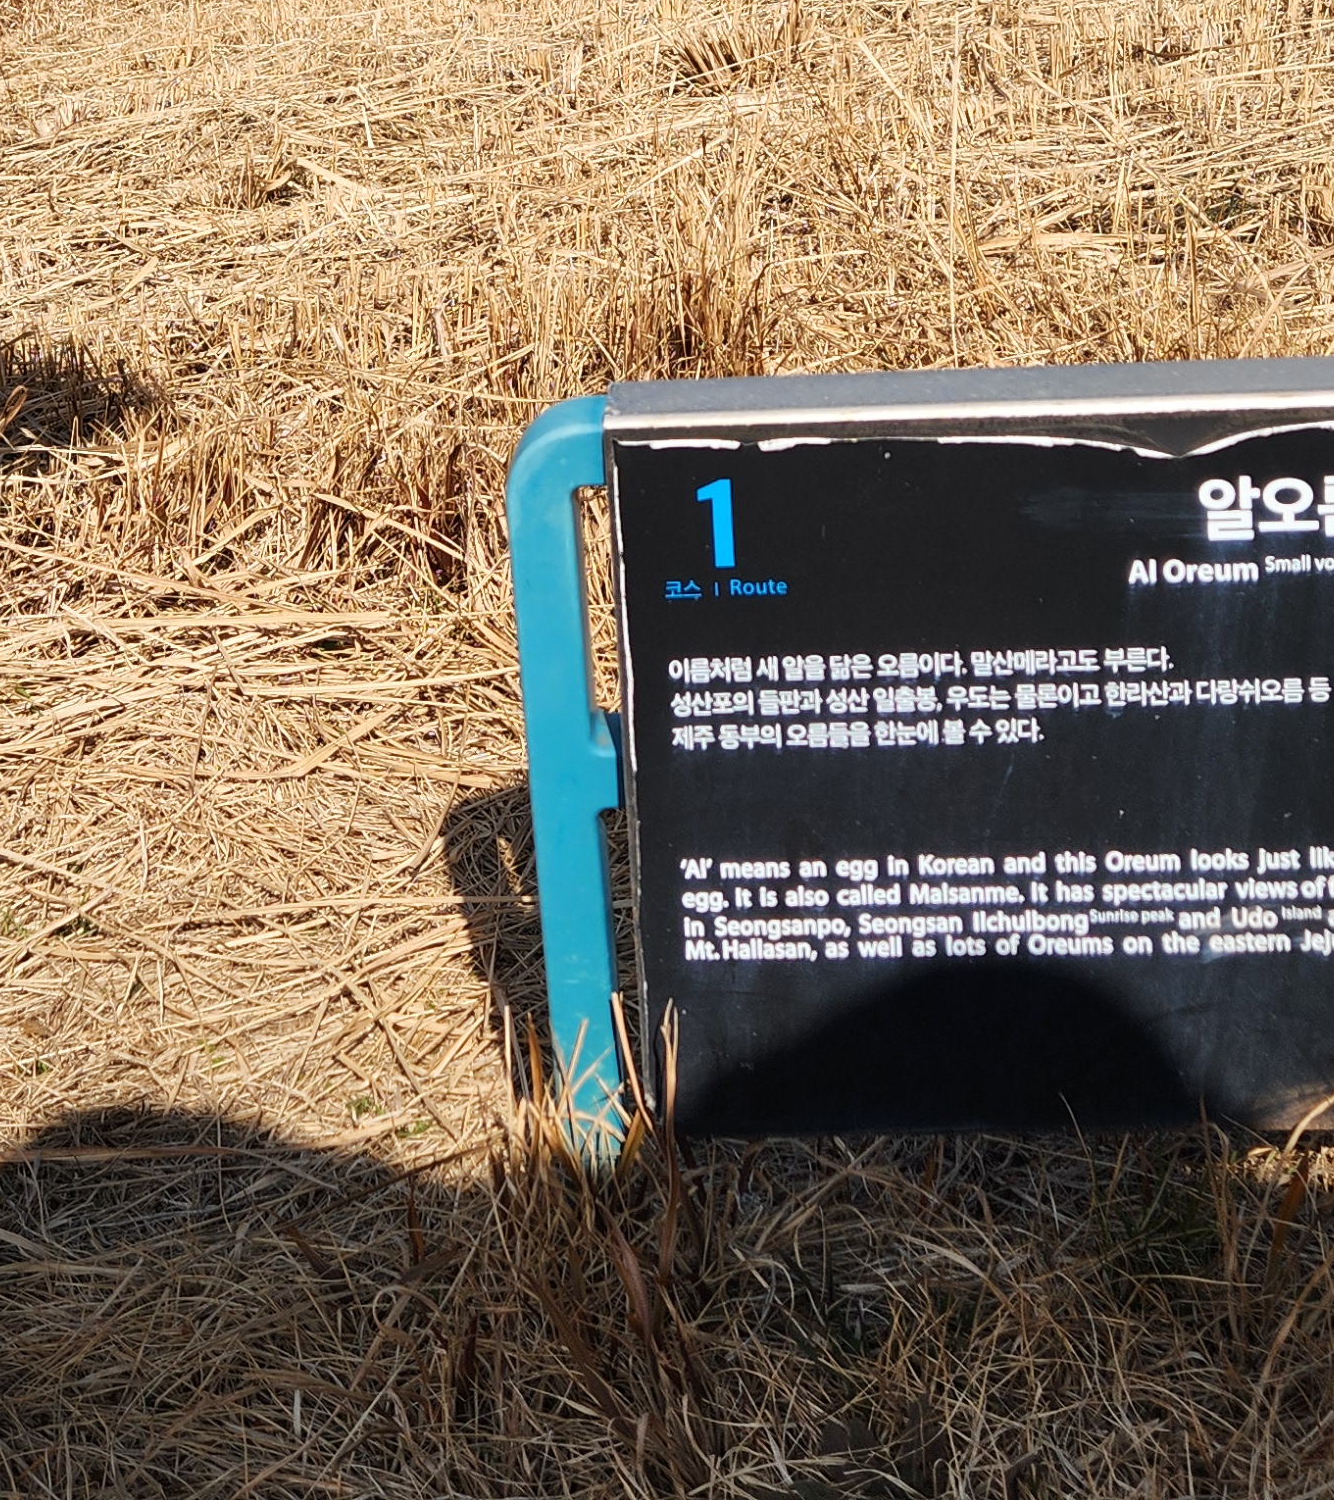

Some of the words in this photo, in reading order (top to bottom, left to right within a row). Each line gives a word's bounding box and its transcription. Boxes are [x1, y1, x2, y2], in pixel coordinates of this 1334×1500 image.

[696, 478, 735, 568] 1
[1128, 559, 1157, 585] Al
[1163, 558, 1259, 584] Oreum
[1265, 555, 1311, 573] Small
[665, 580, 702, 598] 코스
[730, 579, 788, 595] Route
[669, 656, 752, 683] 이름처럼
[756, 656, 779, 681] 새
[782, 655, 826, 682] 알을
[877, 651, 967, 679] 오름이다.
[1103, 646, 1175, 673] 부른다.
[671, 689, 754, 717] 성산포의
[758, 688, 822, 715] 들판과
[826, 687, 868, 714] 성산
[946, 684, 1011, 710] 우도는
[1014, 682, 1102, 710] 물론이고
[1103, 680, 1193, 707] 한라산과
[1196, 678, 1305, 705] 다랑쉬오름
[1308, 676, 1332, 703] 등
[671, 725, 715, 750] 제주
[718, 723, 782, 749] 동부의
[786, 721, 870, 748] 오름들을
[874, 719, 939, 746] 한눈에
[942, 719, 966, 744] 볼
[968, 718, 992, 744] 수
[995, 717, 1045, 743] 있다.
[719, 860, 791, 879] means
[799, 859, 827, 878] an
[836, 858, 879, 881] egg
[887, 855, 909, 876] in
[918, 854, 995, 875] Korean
[1003, 851, 1046, 874] and
[1055, 851, 1097, 873] this
[1105, 851, 1181, 873] Oreum
[1191, 848, 1250, 871] looks
[1257, 847, 1301, 874] just
[681, 891, 729, 912] egg.
[735, 887, 753, 907] It
[759, 886, 778, 907] is
[785, 885, 830, 907] also
[836, 883, 901, 906] called
[909, 882, 1025, 905] Malsanme.
[1031, 881, 1049, 903] It
[1055, 880, 1095, 902] has
[1102, 877, 1228, 906] spectacular
[1235, 877, 1298, 899] views
[1300, 876, 1326, 898] of
[684, 916, 705, 937] in
[714, 915, 851, 940] Seongsanpo,
[858, 913, 963, 937] Seongsan
[972, 909, 1089, 936] Ilchulbong
[1141, 908, 1175, 924] peak
[1178, 907, 1221, 930] and
[1231, 905, 1278, 929] Udo
[722, 938, 817, 962] Hallasan,
[825, 941, 849, 959] as
[857, 936, 902, 958] well
[912, 938, 936, 957] as
[945, 934, 987, 956] lots
[995, 933, 1021, 956] of
[1027, 933, 1114, 956] Oreums
[1123, 934, 1153, 953] on
[1162, 930, 1200, 953] the
[1209, 931, 1291, 953] eastern
